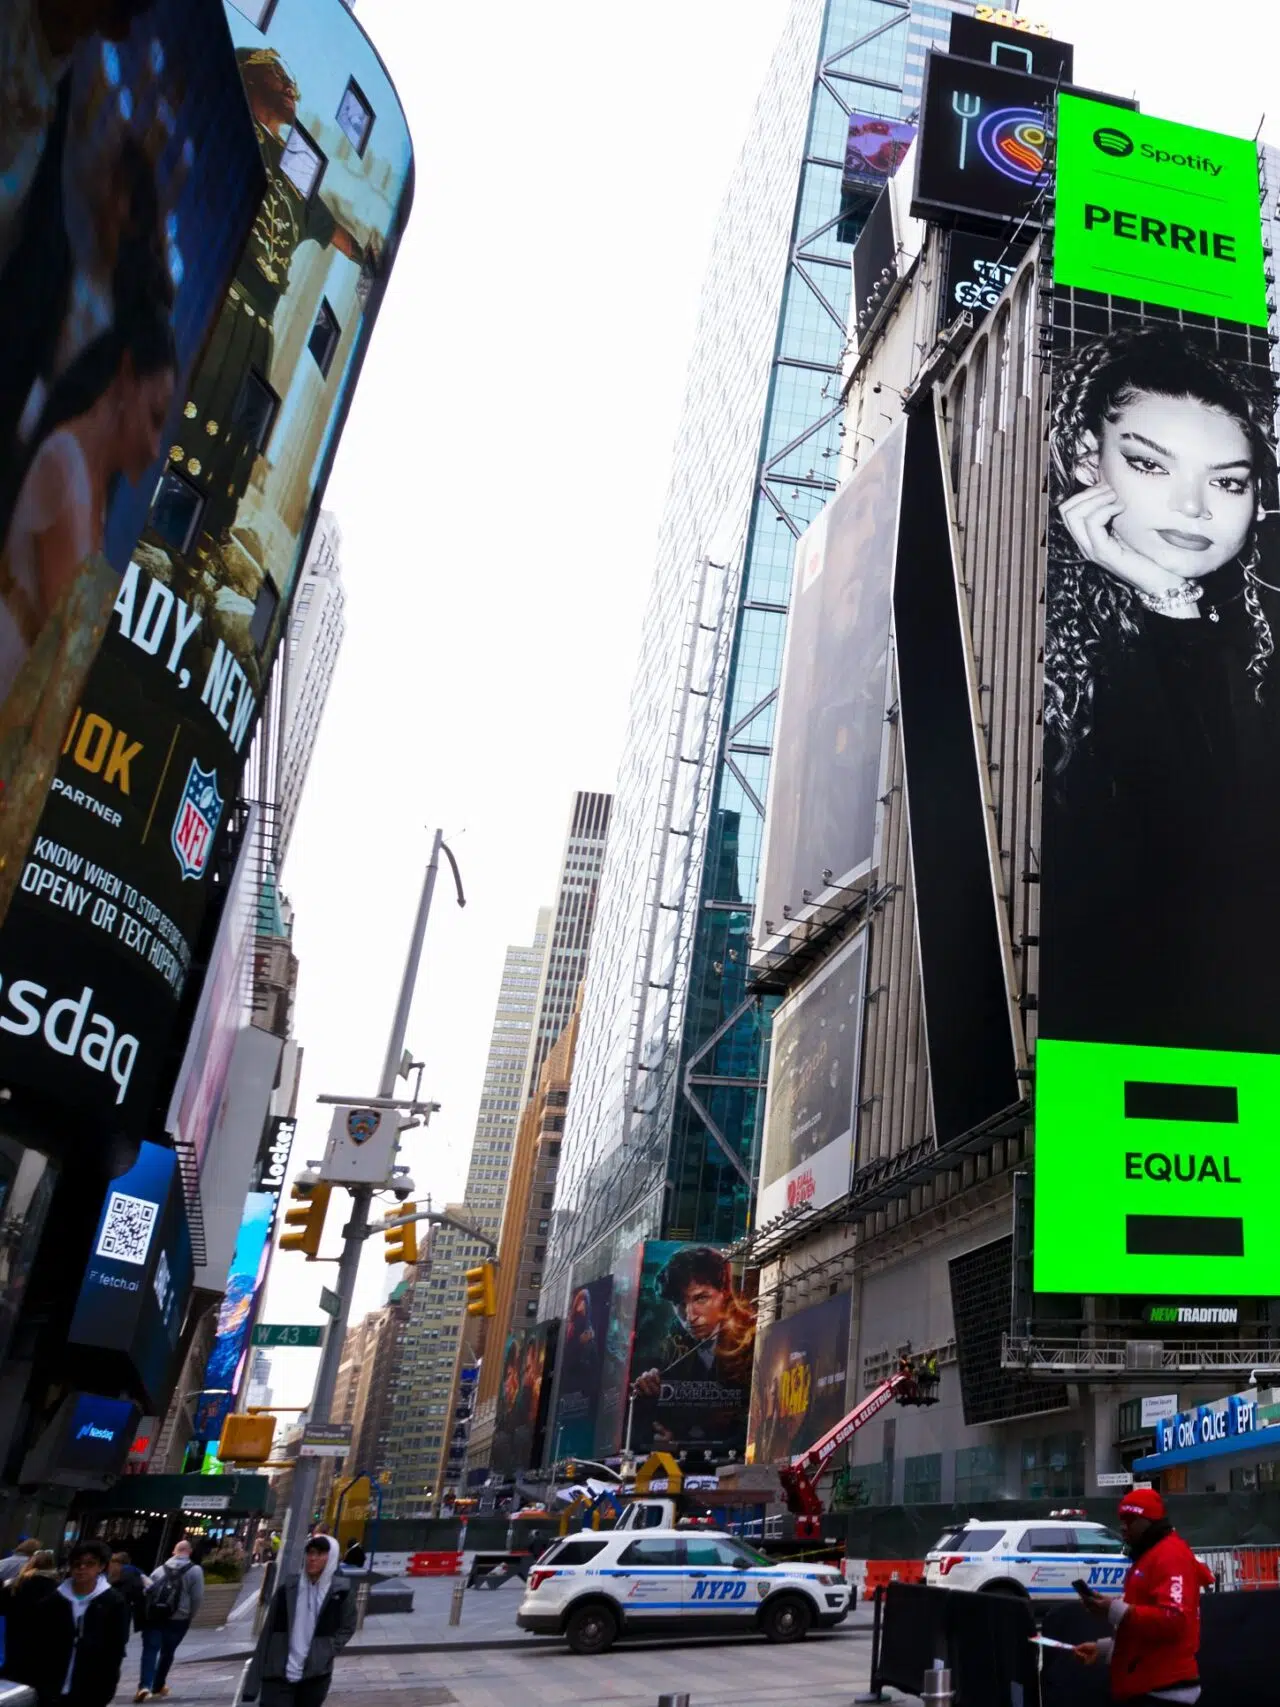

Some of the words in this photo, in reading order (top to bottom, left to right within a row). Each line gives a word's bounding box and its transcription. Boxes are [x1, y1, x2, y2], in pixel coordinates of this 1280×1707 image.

[1140, 143, 1223, 176] Spotify
[1084, 203, 1236, 263] PERRIE
[200, 638, 255, 754] NEW
[62, 706, 144, 795] OK
[51, 778, 122, 828] PARTNER
[178, 801, 209, 868] NFL
[21, 863, 92, 916] OPENY
[91, 898, 118, 933] OR
[118, 912, 152, 956] TEXT
[34, 836, 84, 875] KNOW
[83, 860, 123, 898] WHEN
[122, 884, 138, 908] TO
[136, 895, 161, 926] STOP
[0, 973, 140, 1105] sdaq
[1125, 1152, 1241, 1183] EQUAL
[99, 1268, 140, 1292] fetch.ai
[257, 1328, 273, 1344] W
[276, 1327, 301, 1344] 43
[836, 1422, 855, 1444] SIGN
[860, 1389, 893, 1422] ELECTRIC
[691, 1580, 747, 1600] NYPD
